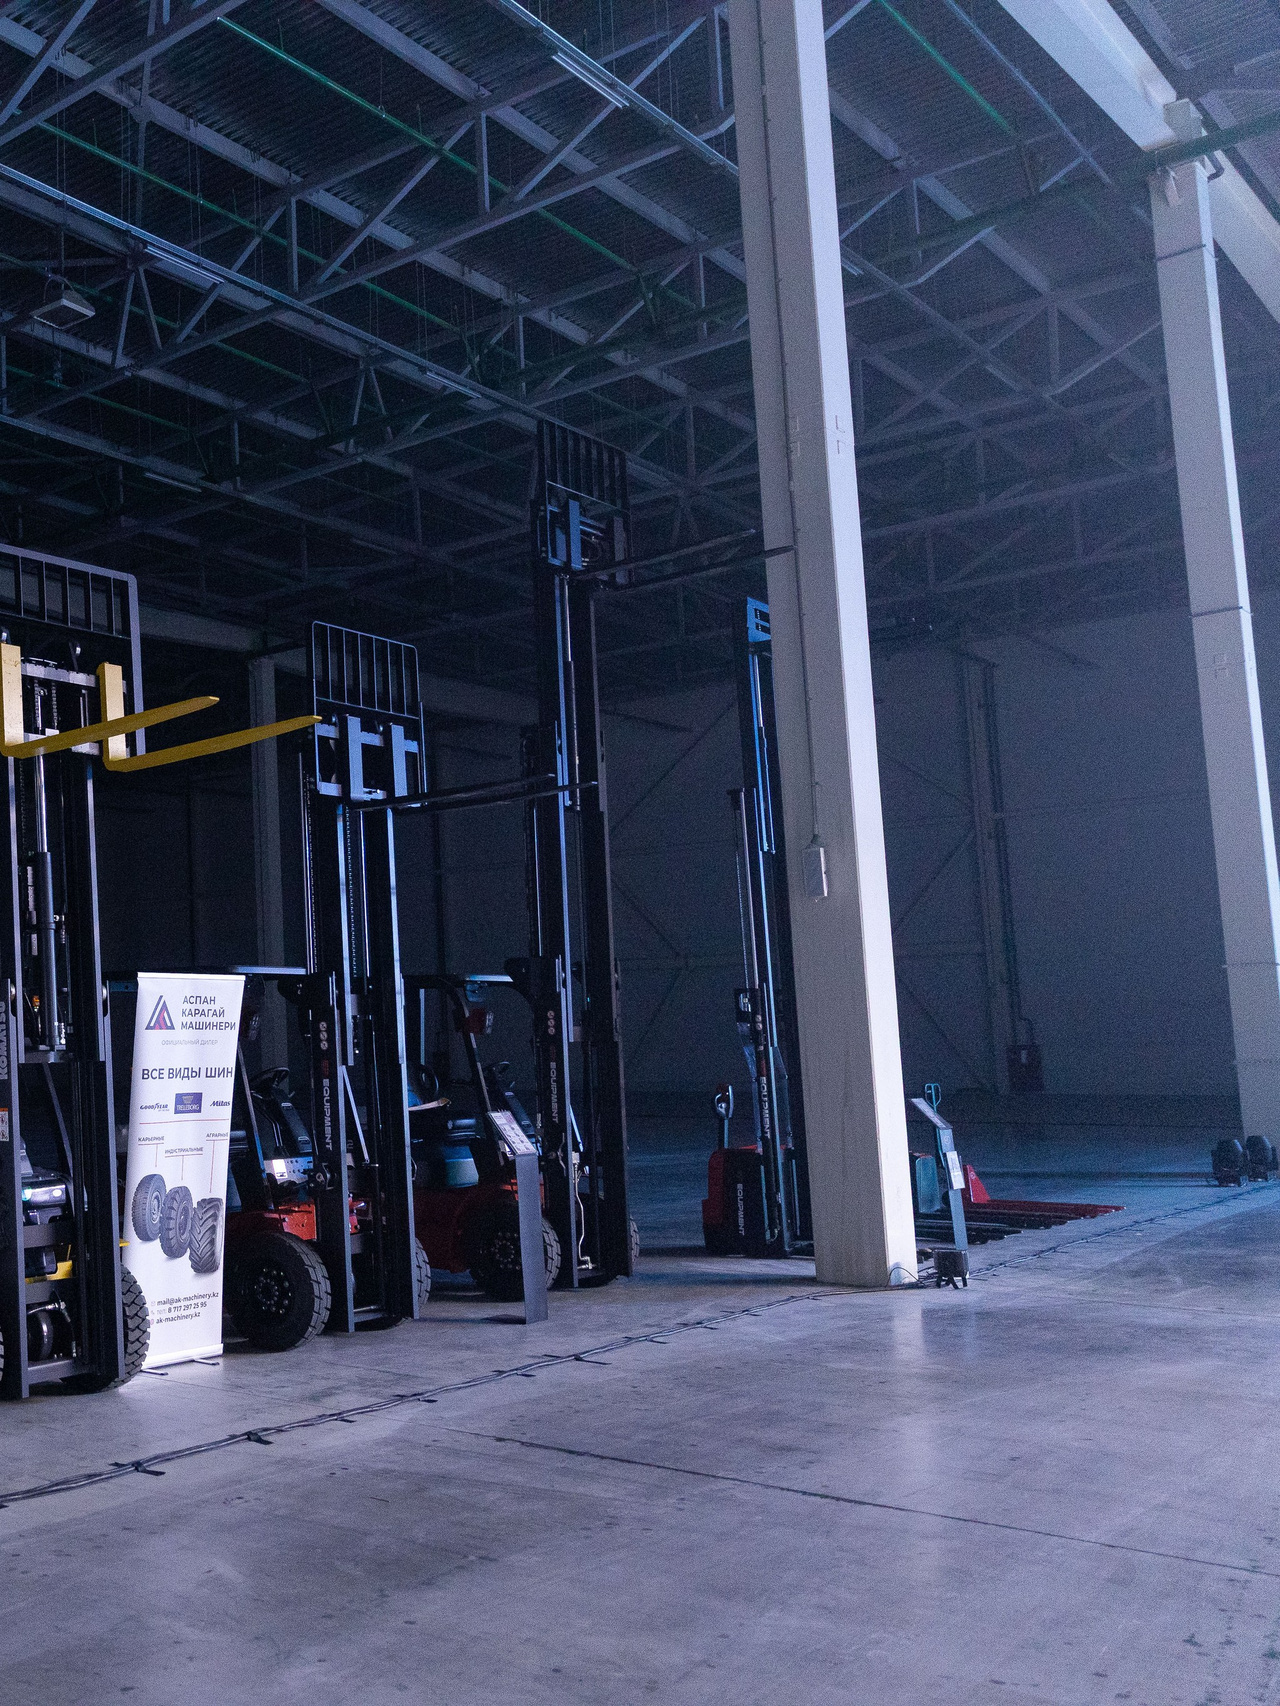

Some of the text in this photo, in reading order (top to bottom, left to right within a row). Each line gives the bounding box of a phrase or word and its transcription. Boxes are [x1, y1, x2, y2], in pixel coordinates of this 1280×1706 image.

[183, 996, 215, 1005] АСПАН
[182, 1007, 224, 1017] КАРАГАЙ
[181, 1022, 236, 1031] МАШИНЕРИ
[142, 1067, 233, 1080] ВСЕ ВИДЫ ШИН
[550, 1062, 559, 1124] EQUIPMENT
[760, 1076, 771, 1139] EQUIPMENT
[323, 1079, 332, 1151] EQUIPMENT
[737, 1183, 745, 1236] EQUIPMENT
[157, 1292, 219, 1306] mail@ak-machinery.kz
[156, 1312, 200, 1324] ak-machinery.kz
